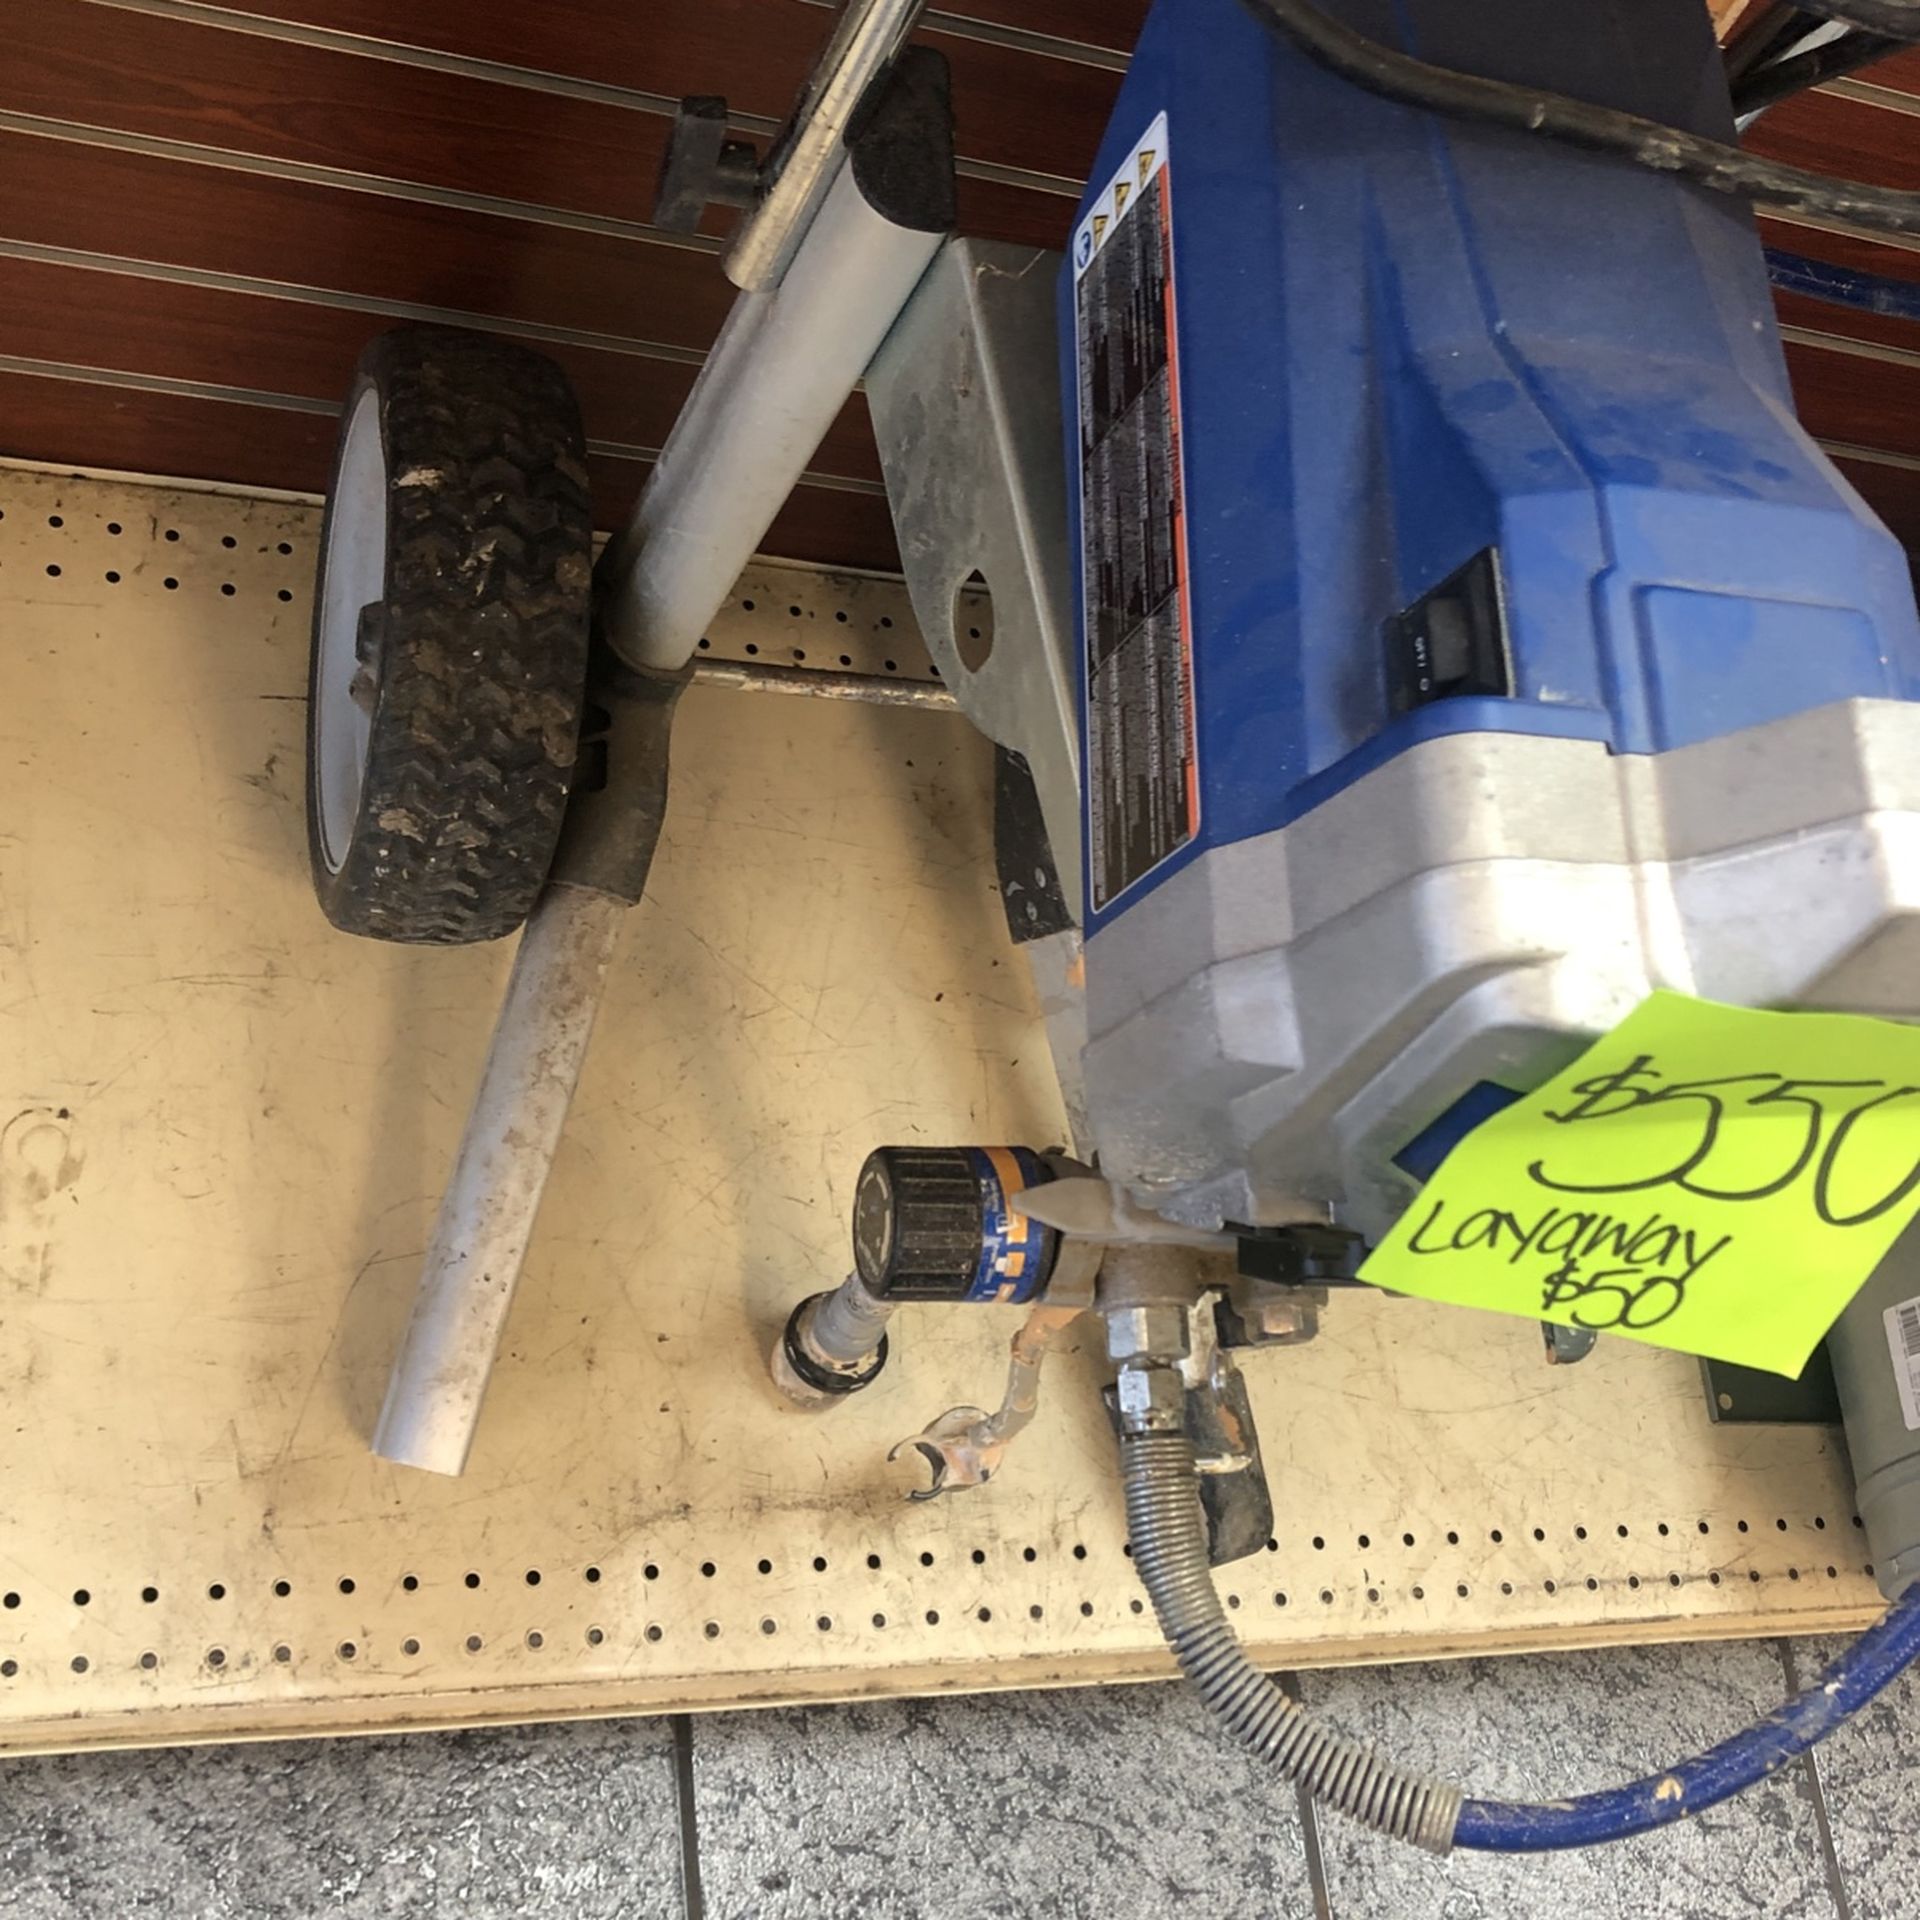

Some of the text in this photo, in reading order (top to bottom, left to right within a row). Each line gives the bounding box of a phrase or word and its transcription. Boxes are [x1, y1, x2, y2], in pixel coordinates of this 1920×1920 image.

[1528, 1055, 1920, 1226] $550
[1407, 1199, 1732, 1284] Layaway
[1541, 1257, 1685, 1330] $50
